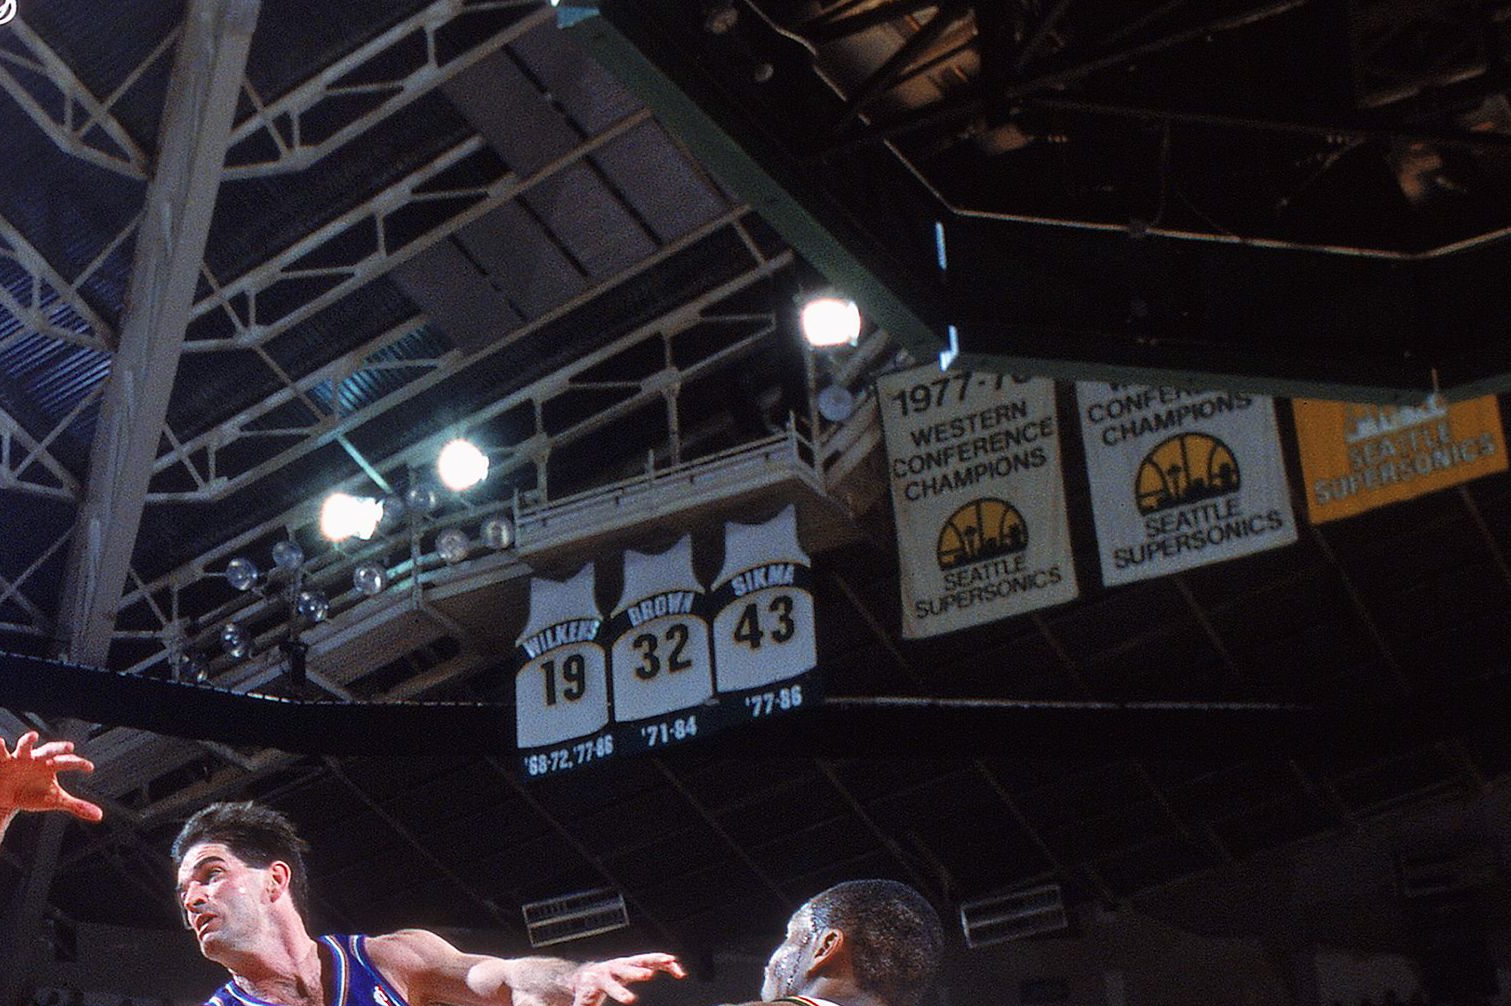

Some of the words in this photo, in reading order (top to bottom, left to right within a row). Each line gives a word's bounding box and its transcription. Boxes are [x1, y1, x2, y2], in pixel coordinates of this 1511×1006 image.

[893, 416, 1053, 478] CONFERENCE
[910, 401, 1028, 447] WESTERN
[1102, 396, 1252, 447] CHAMPIONS
[904, 447, 1048, 502] CHAMPIONS
[1113, 509, 1284, 571] SUPERSONICS
[1144, 500, 1243, 540] SEATTLE
[915, 566, 1062, 620] SUPERSONICS
[942, 553, 1026, 592] SEATTLE
[735, 595, 794, 650] 43
[633, 623, 692, 681] 32
[541, 653, 586, 706] 19
